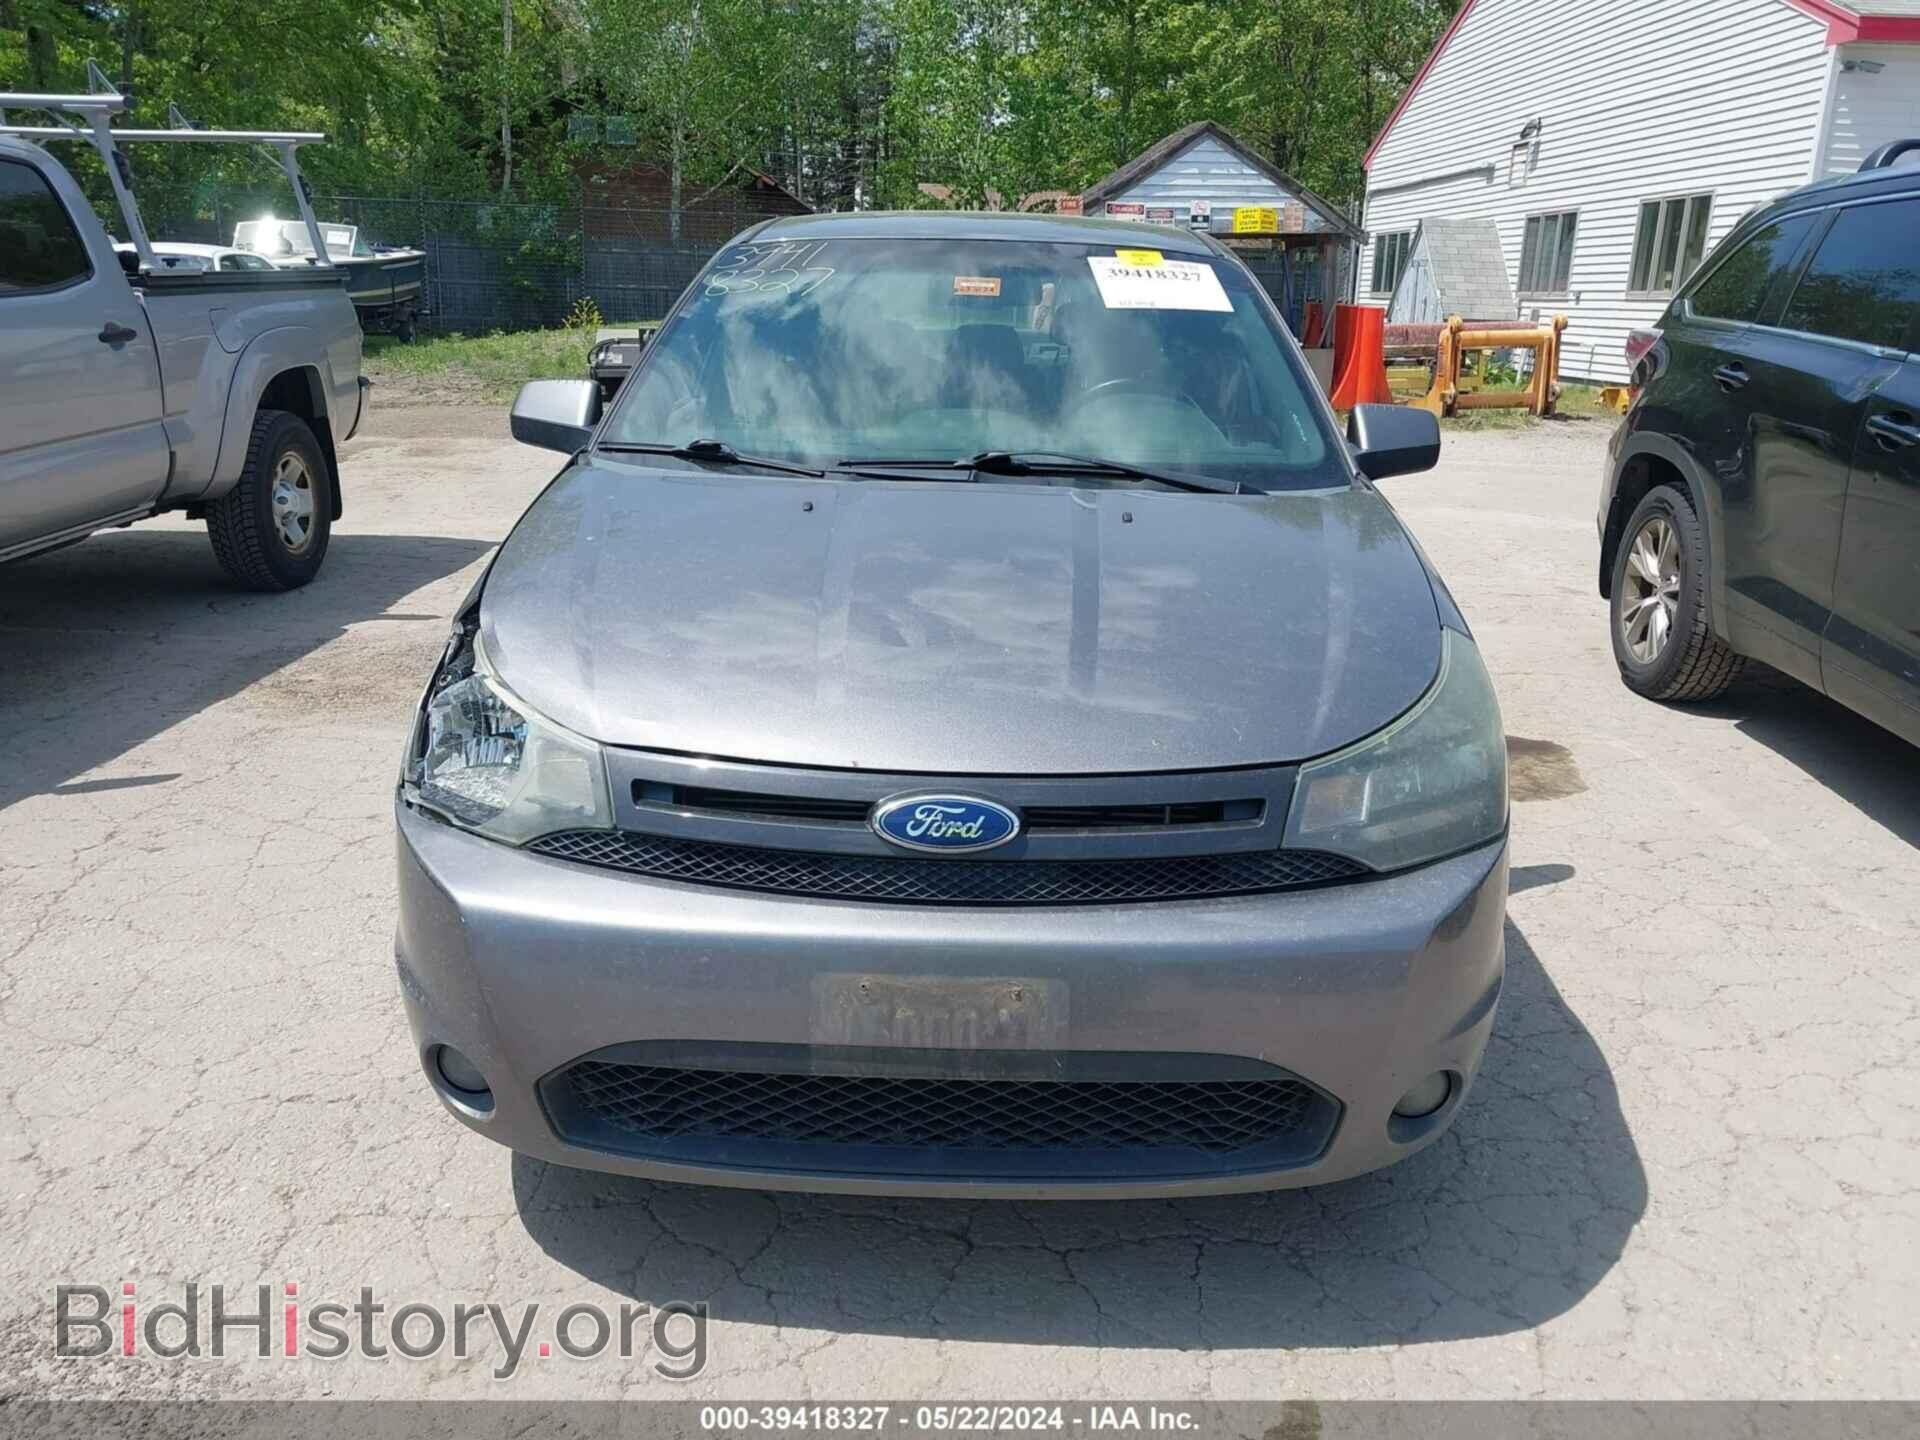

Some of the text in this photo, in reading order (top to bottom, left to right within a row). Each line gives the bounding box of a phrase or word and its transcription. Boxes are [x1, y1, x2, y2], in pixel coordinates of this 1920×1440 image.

[705, 267, 835, 296] 8327
[1108, 268, 1201, 281] 39418327
[906, 804, 985, 838] Ford
